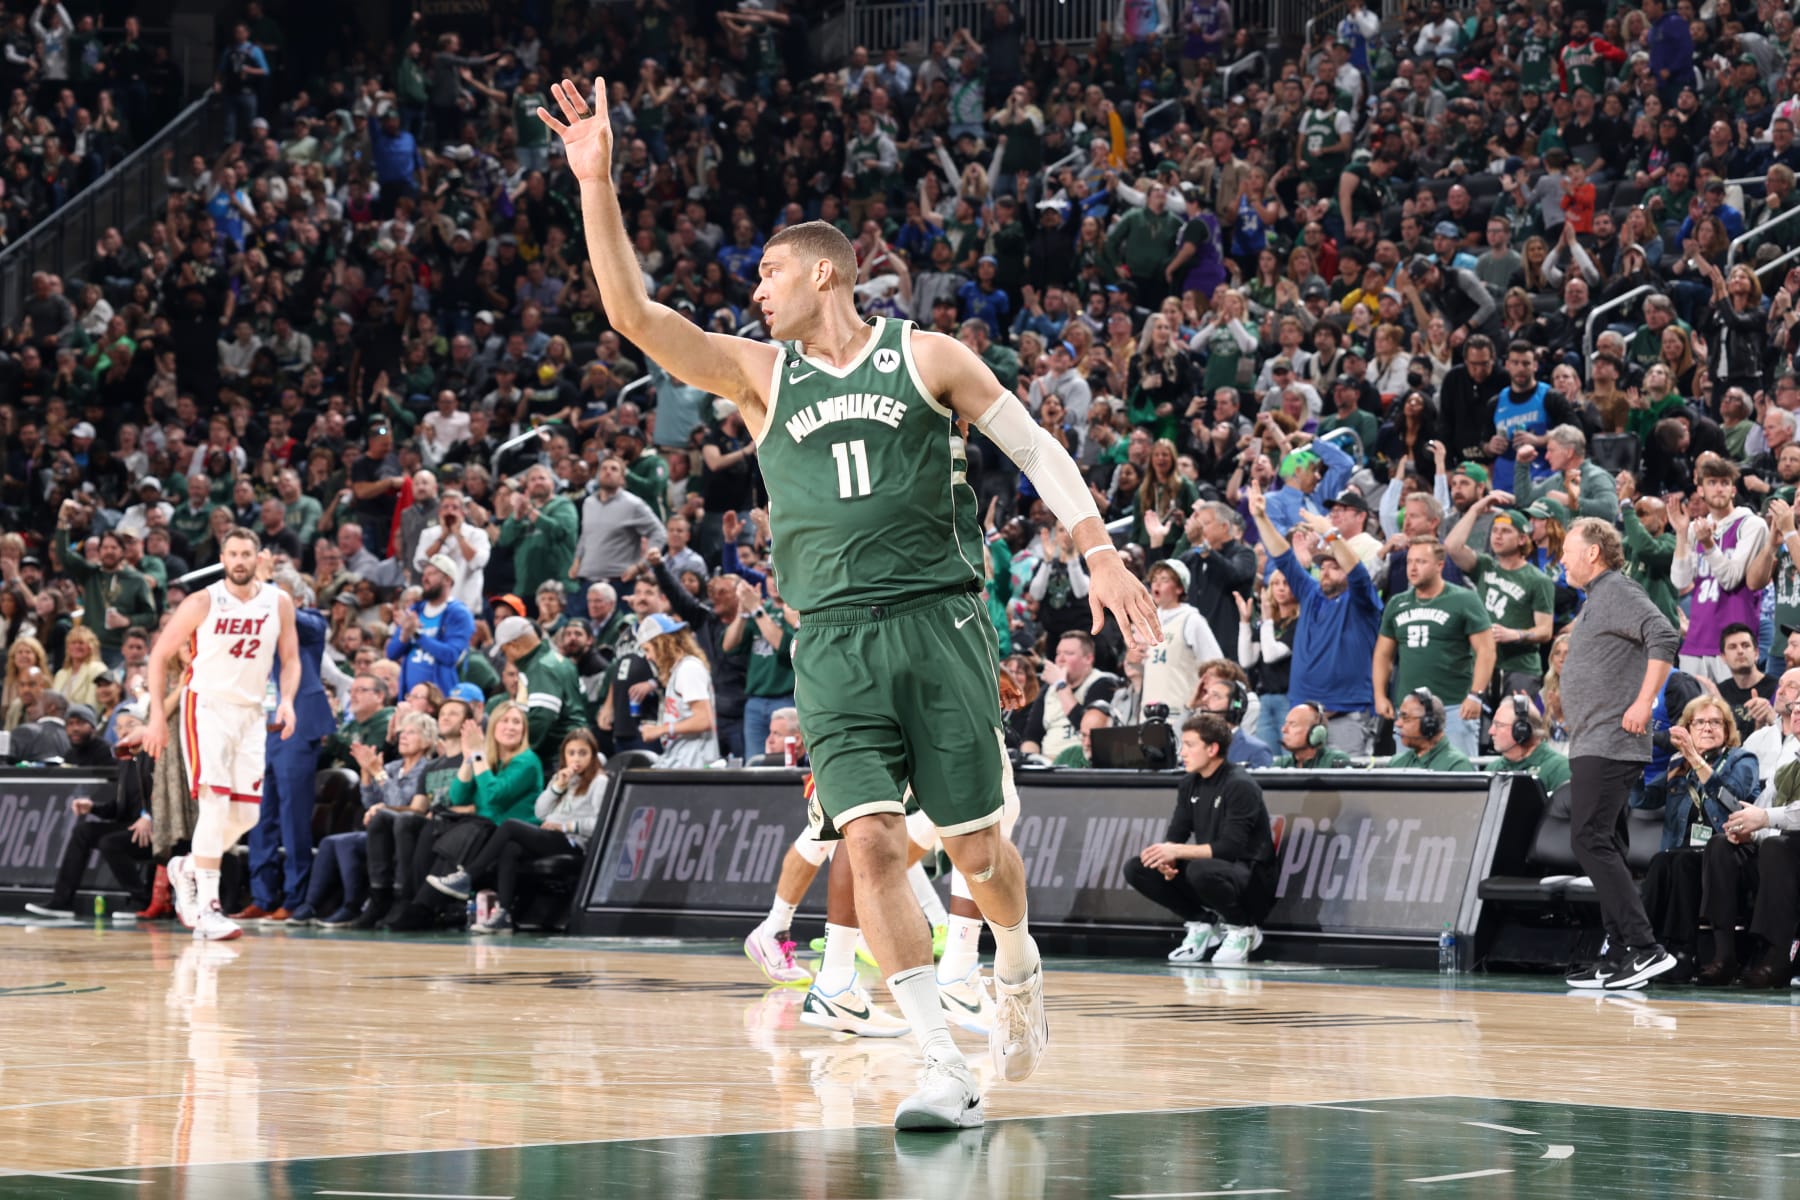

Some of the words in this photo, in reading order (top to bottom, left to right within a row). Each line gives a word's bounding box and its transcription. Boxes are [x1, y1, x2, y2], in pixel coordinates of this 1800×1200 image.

[784, 393, 908, 444] MILWAUKEE
[831, 439, 871, 499] 11
[214, 613, 269, 635] HEAT
[1394, 607, 1450, 627] MILWAUKEE
[229, 638, 261, 659] 42
[1152, 648, 1167, 664] 34
